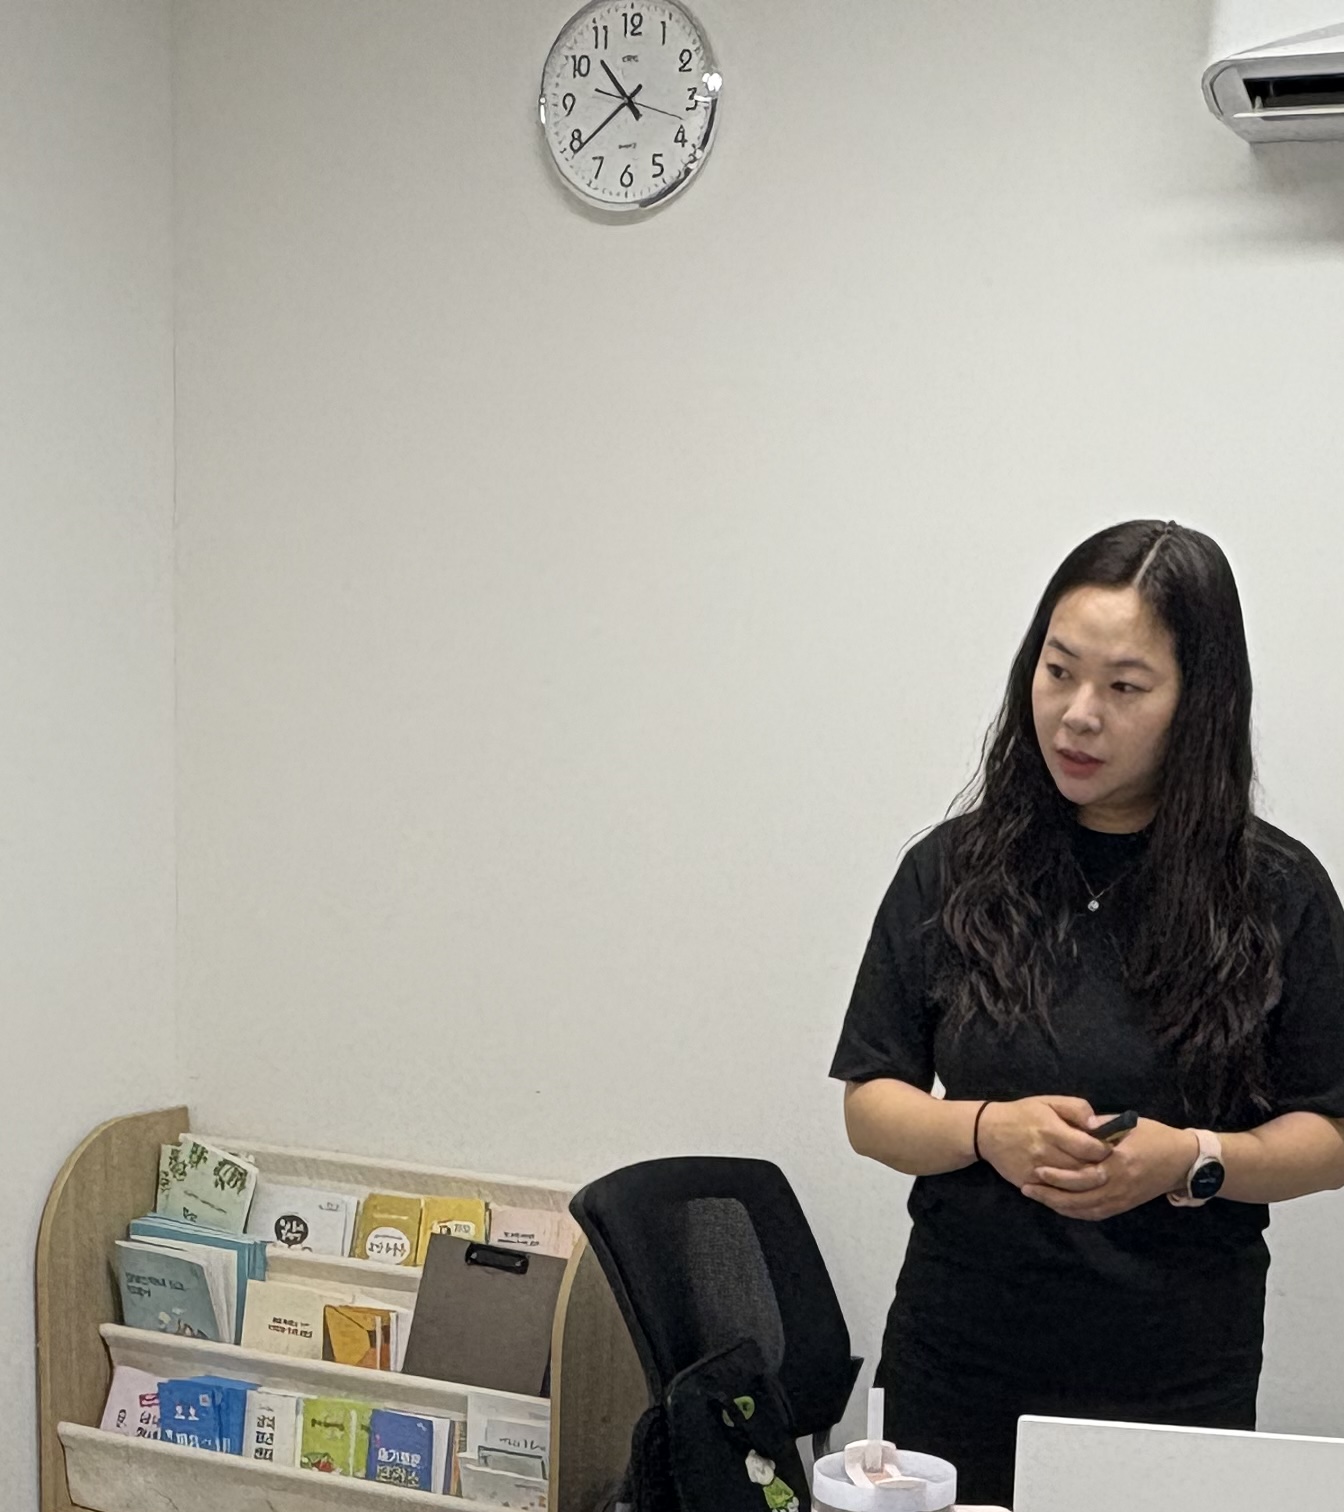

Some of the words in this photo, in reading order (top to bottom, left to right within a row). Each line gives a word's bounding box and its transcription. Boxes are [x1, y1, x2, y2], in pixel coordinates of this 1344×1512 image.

[592, 24, 609, 50] 11
[621, 12, 644, 38] 12
[660, 20, 667, 46] 1
[571, 54, 591, 79] 10
[678, 48, 693, 73] 2
[561, 92, 577, 118] 9
[685, 86, 698, 112] 3
[568, 128, 584, 152] 8
[673, 124, 688, 148] 4
[591, 155, 605, 180] 7
[619, 163, 634, 188] 6
[651, 152, 665, 179] 5
